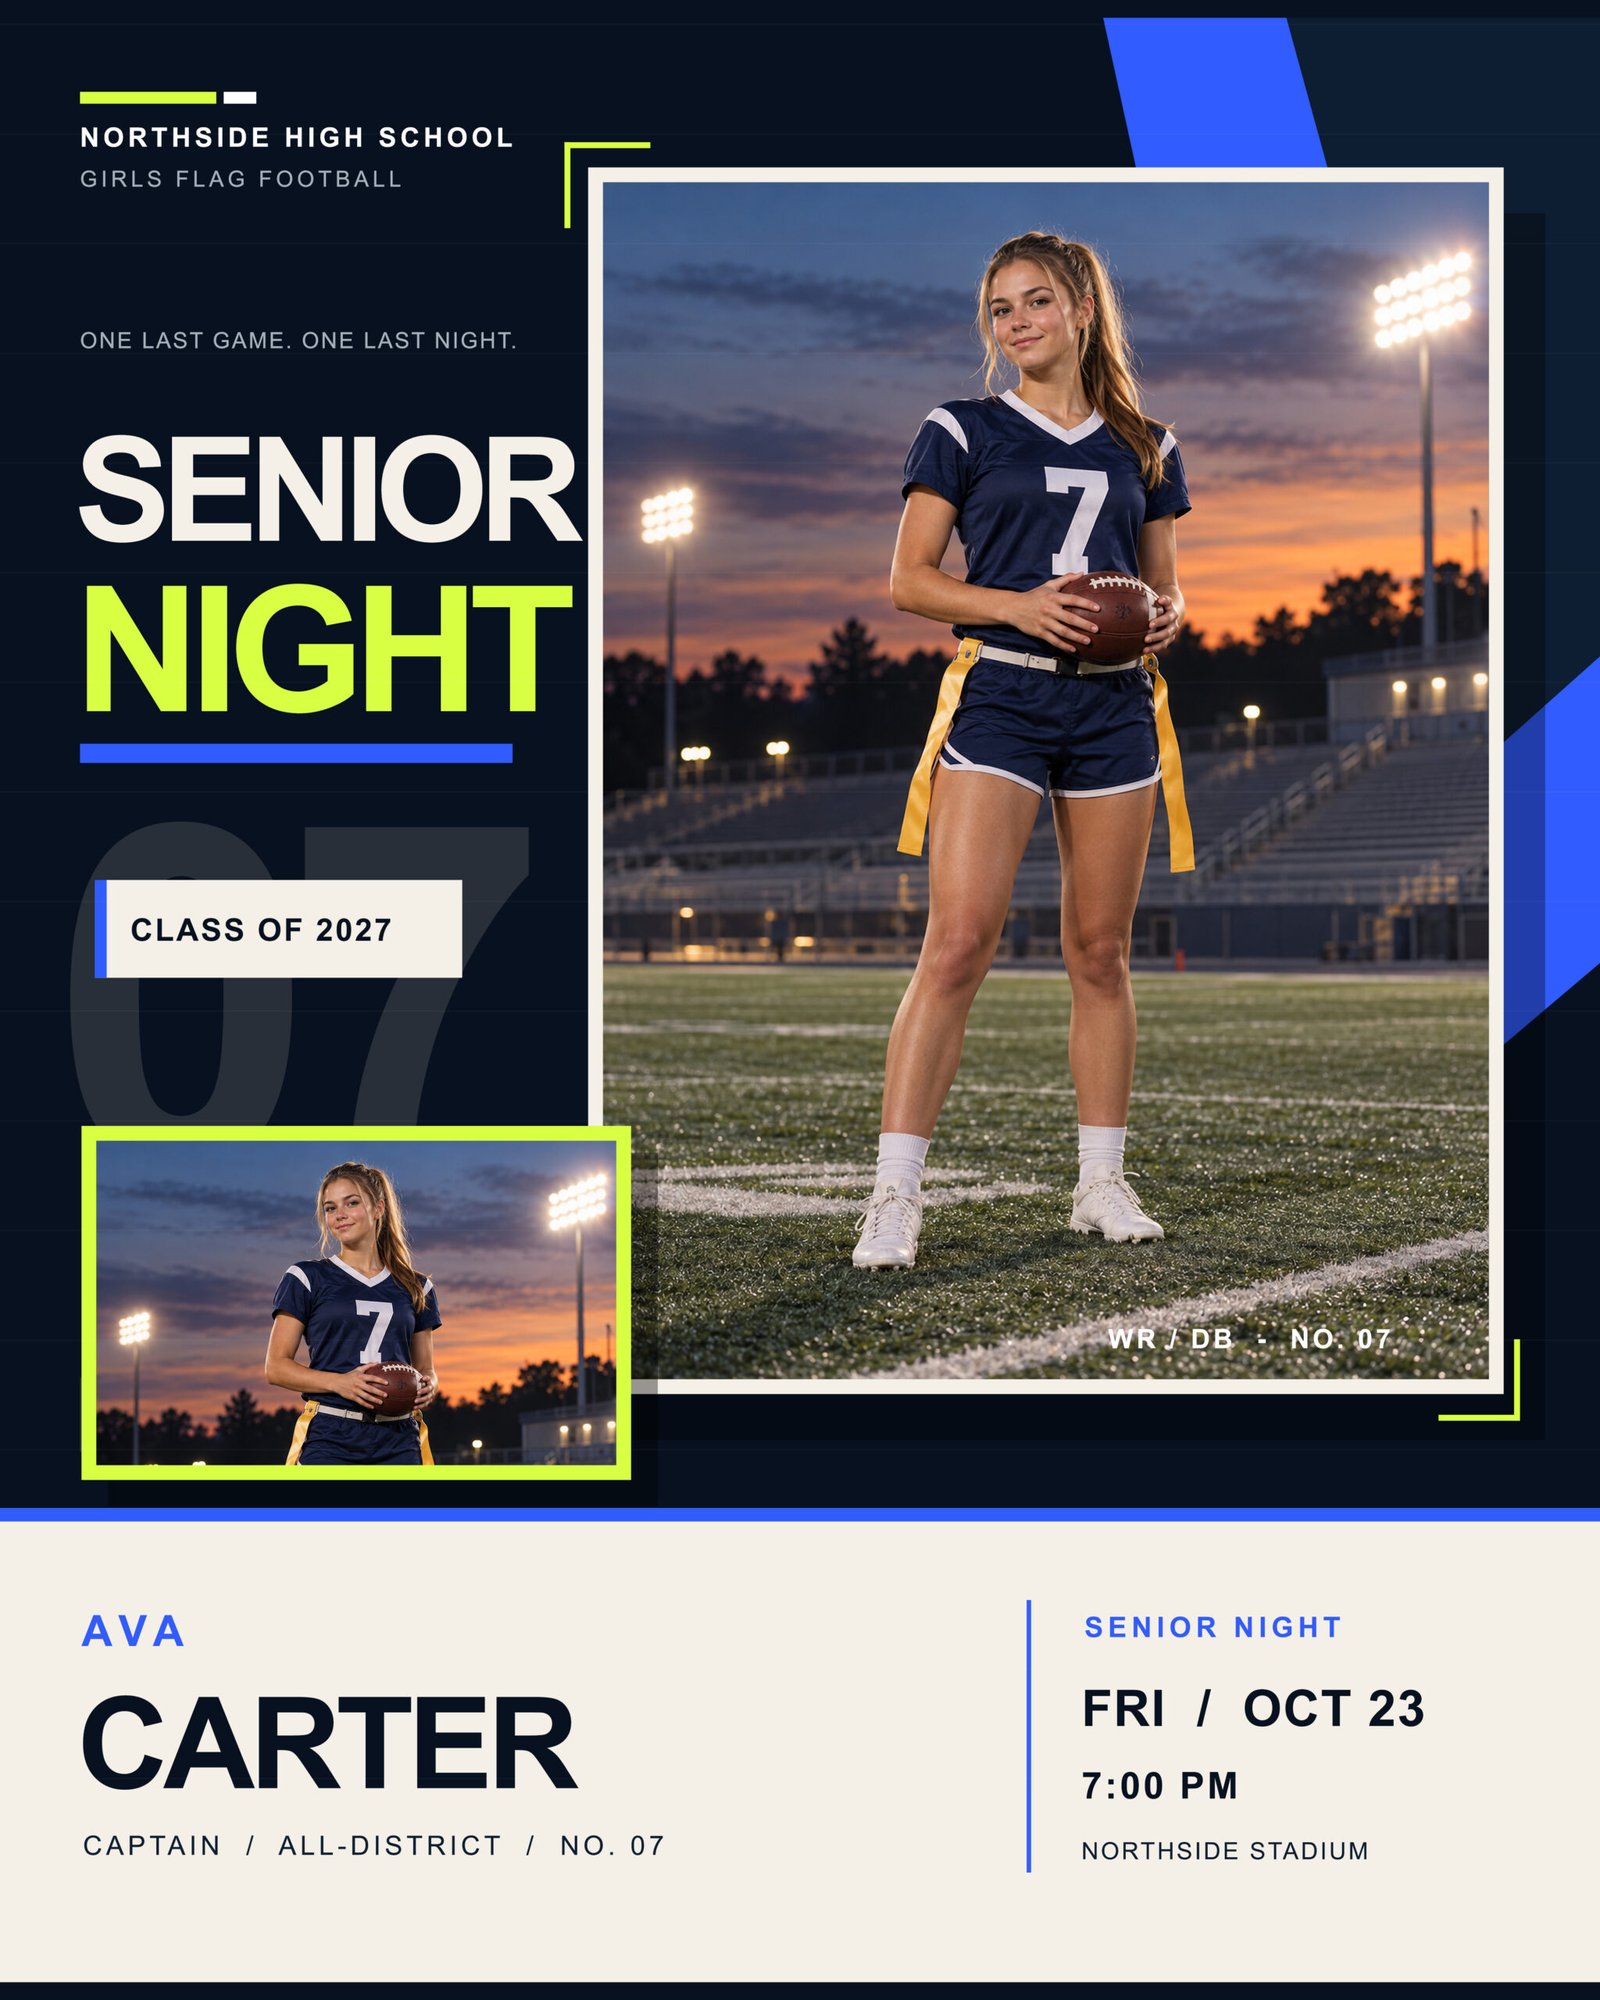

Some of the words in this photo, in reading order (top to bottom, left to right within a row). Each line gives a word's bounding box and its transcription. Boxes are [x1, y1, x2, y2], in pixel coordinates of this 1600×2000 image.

[81, 127, 268, 147] NORTHSIDE
[286, 127, 361, 147] HIGH
[379, 127, 512, 147] SCHOOL
[81, 170, 161, 187] GIRLS
[177, 170, 244, 187] FLAG
[260, 170, 401, 187] FOOTBALL
[81, 332, 131, 349] ONE
[143, 332, 203, 349] LAST
[214, 332, 290, 349] GAME.
[303, 332, 353, 349] ONE
[365, 332, 425, 349] LAST
[436, 332, 517, 349] NIGHT.
[79, 435, 583, 543] SENIOR
[1044, 466, 1109, 575] 7
[87, 583, 573, 714] NIGHT
[131, 917, 244, 942] CLASS
[258, 917, 303, 942] OF
[316, 917, 391, 942] 2027
[70, 821, 529, 1126] 07
[355, 1299, 394, 1364] 7
[82, 1615, 184, 1646] AVA
[1085, 1616, 1217, 1638] SENIOR
[1235, 1616, 1341, 1638] NIGHT
[1084, 1690, 1163, 1726] FRI
[1197, 1689, 1211, 1727] /
[1243, 1689, 1351, 1727] OCT
[1369, 1689, 1424, 1727] 23
[83, 1695, 578, 1790] CARTER
[1083, 1772, 1163, 1799] 7:00
[1182, 1772, 1237, 1799] PM
[84, 1835, 219, 1856] CAPTAIN
[246, 1835, 254, 1855] /
[278, 1835, 501, 1856] ALL-DISTRICT
[526, 1835, 534, 1855] /
[562, 1835, 614, 1856] NO.
[631, 1835, 664, 1856] 07
[1083, 1842, 1238, 1860] NORTHSIDE
[1251, 1842, 1368, 1860] STADIUM
